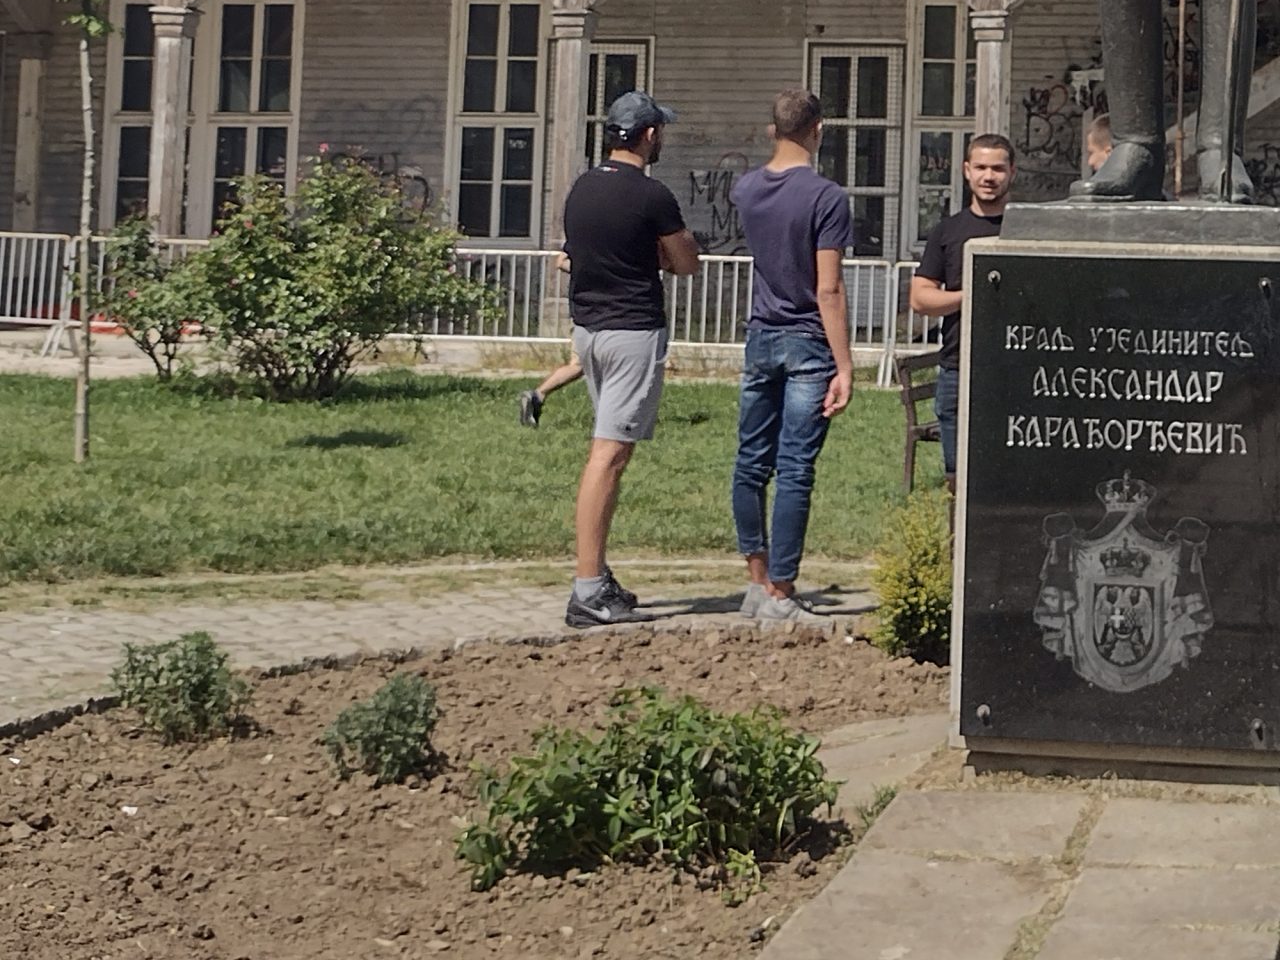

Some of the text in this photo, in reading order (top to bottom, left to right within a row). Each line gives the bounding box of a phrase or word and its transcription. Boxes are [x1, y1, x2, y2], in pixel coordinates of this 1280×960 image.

[1005, 324, 1254, 357] КРАЉ УЈЕДИНИТЕЉ
[1032, 366, 1224, 402] АЛЕКСАНДАР
[1006, 415, 1248, 455] КАРАЂОРЂЕВИЋ
